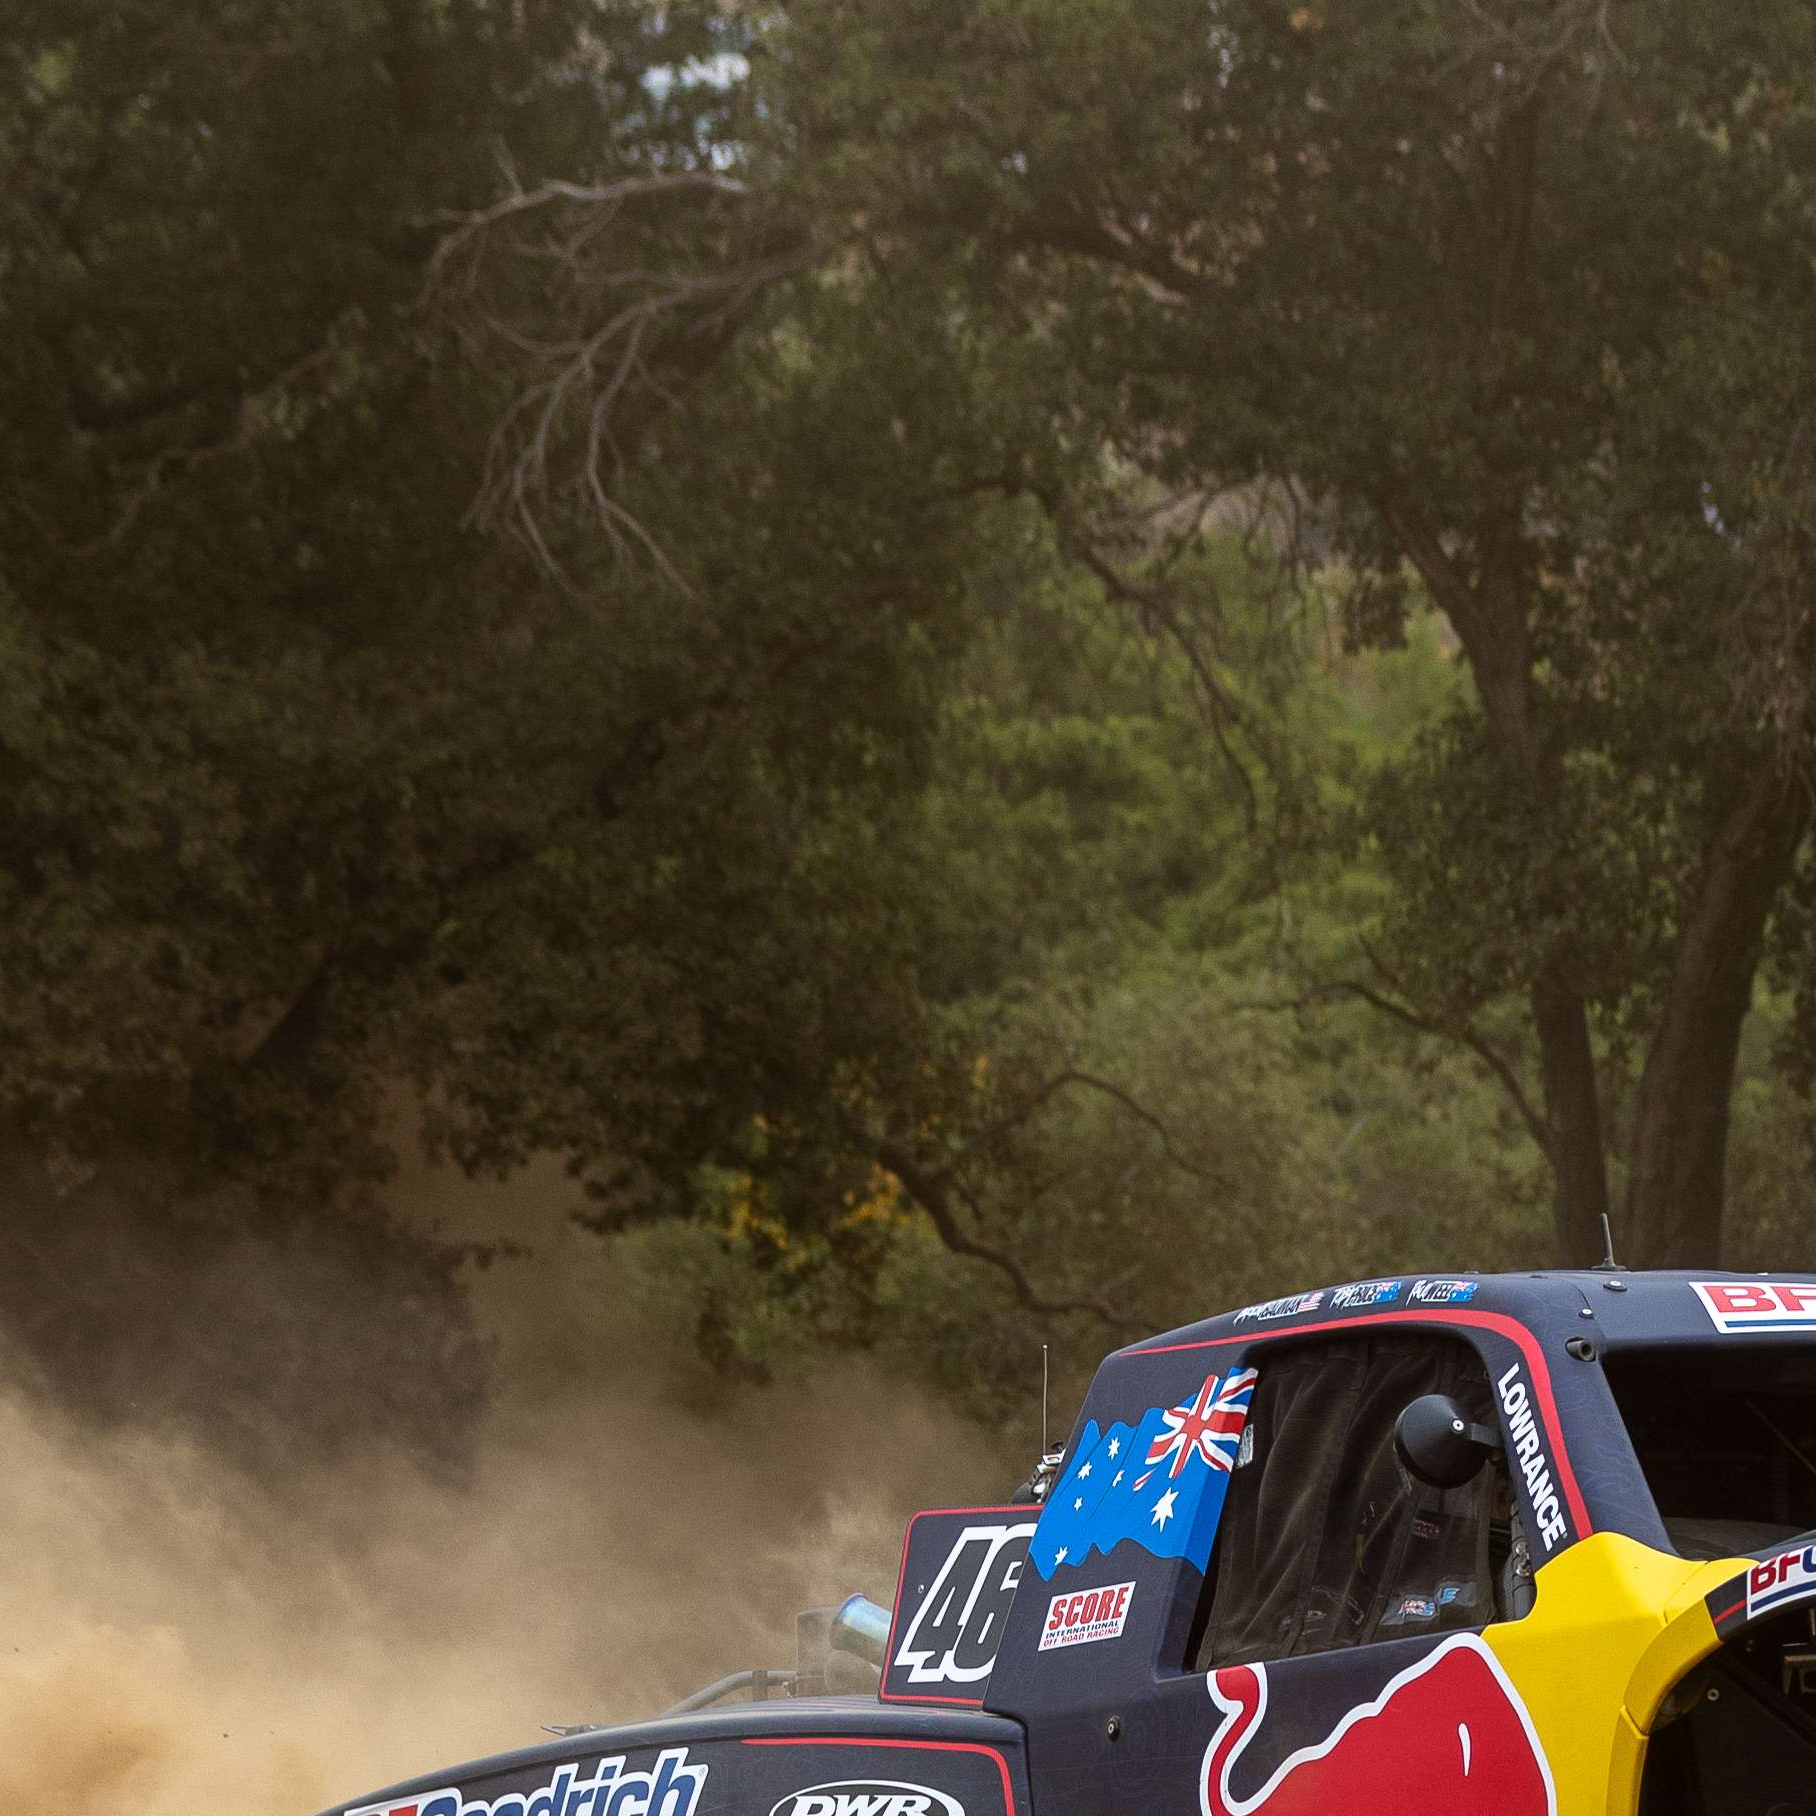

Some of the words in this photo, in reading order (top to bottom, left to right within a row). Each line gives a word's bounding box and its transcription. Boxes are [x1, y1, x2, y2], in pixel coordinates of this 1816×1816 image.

[1497, 1362, 1567, 1551] LOWRANCE
[894, 1523, 1039, 1683] 46
[1046, 1620, 1119, 1639] INTERNATIONAL
[1048, 1586, 1130, 1631] SCORE
